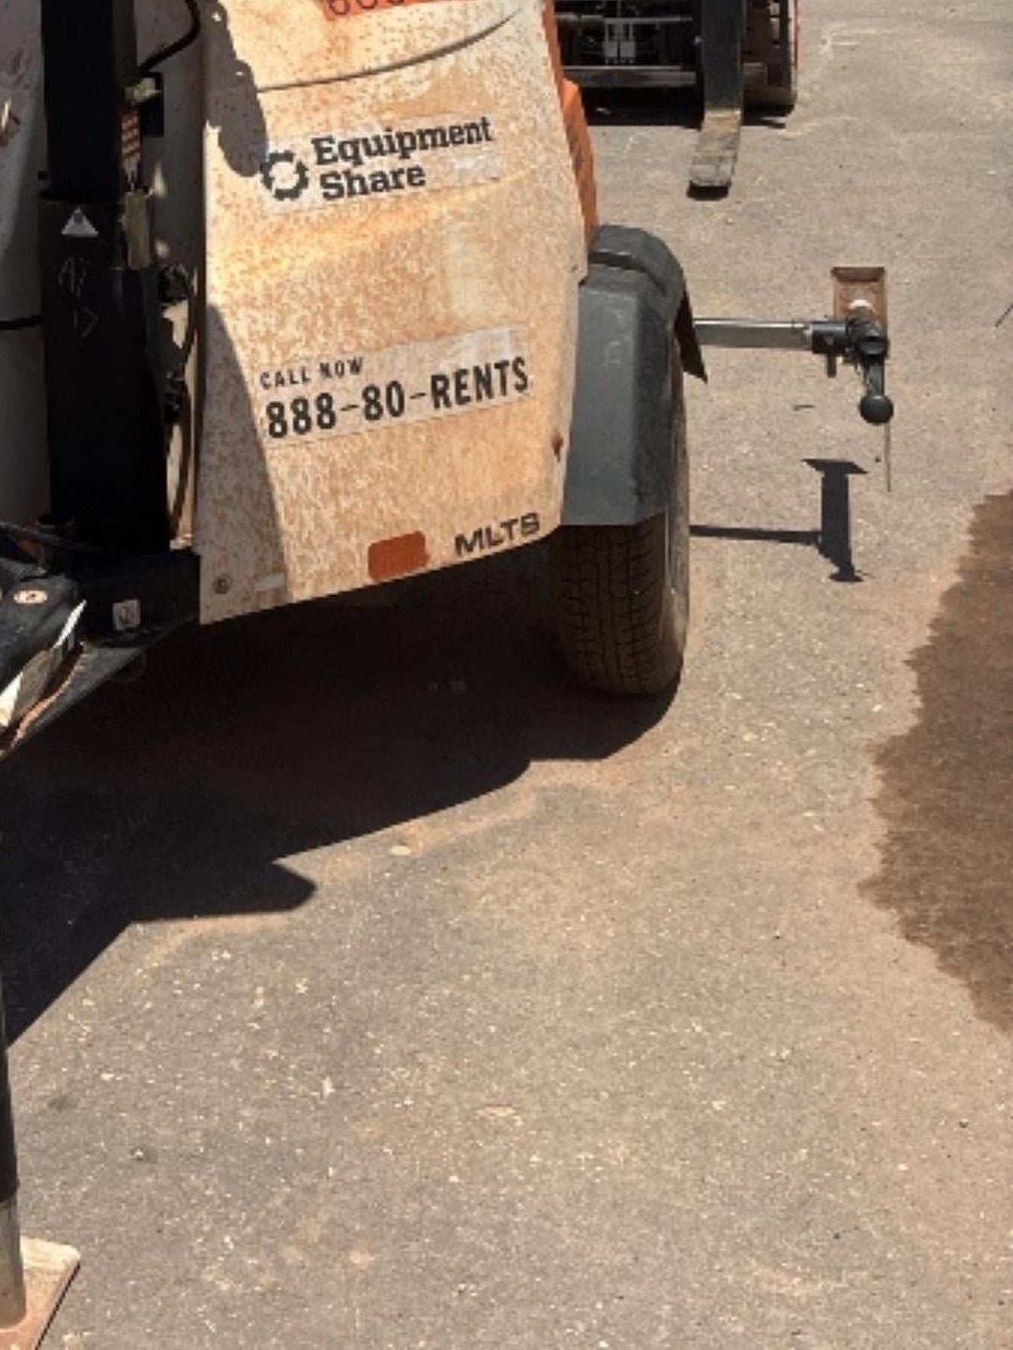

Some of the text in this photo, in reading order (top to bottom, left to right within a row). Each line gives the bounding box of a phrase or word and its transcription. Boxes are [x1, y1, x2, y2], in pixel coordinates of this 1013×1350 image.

[311, 116, 493, 166] Equipment
[319, 164, 426, 201] Share
[259, 357, 364, 389] CALL NOW
[265, 356, 529, 439] 888-80-RENTS
